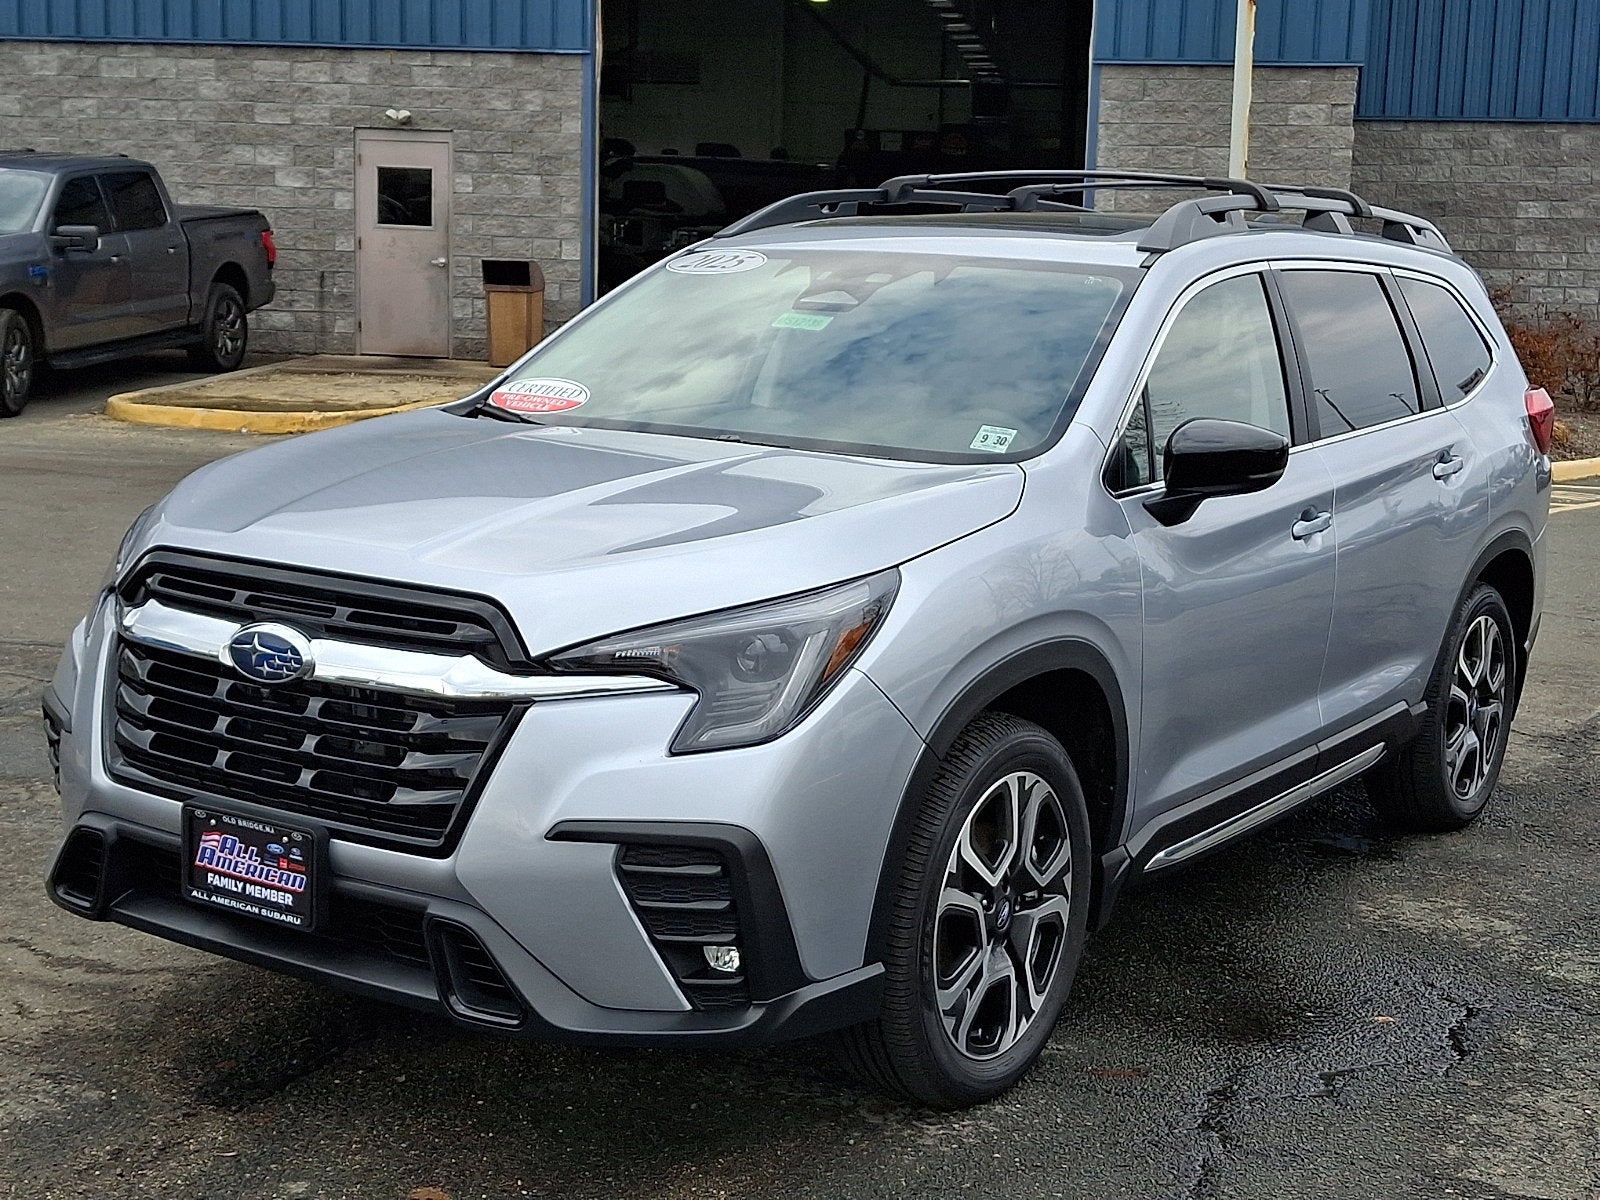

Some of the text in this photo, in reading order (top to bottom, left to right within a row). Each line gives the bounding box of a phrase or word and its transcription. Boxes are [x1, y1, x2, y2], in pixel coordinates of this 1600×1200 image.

[678, 254, 758, 269] 2025
[509, 381, 583, 399] CERTIFIED
[501, 393, 567, 406] PRE-OWNED
[505, 400, 550, 410] VEHICLE
[980, 434, 989, 443] 9
[993, 436, 1008, 446] 30
[222, 815, 236, 825] OLD
[218, 834, 261, 864] ALL
[196, 844, 307, 892] AMERICAN
[207, 872, 293, 906] FAMILY MEMBER
[191, 889, 301, 925] ALL AMERICAN SUBARU
